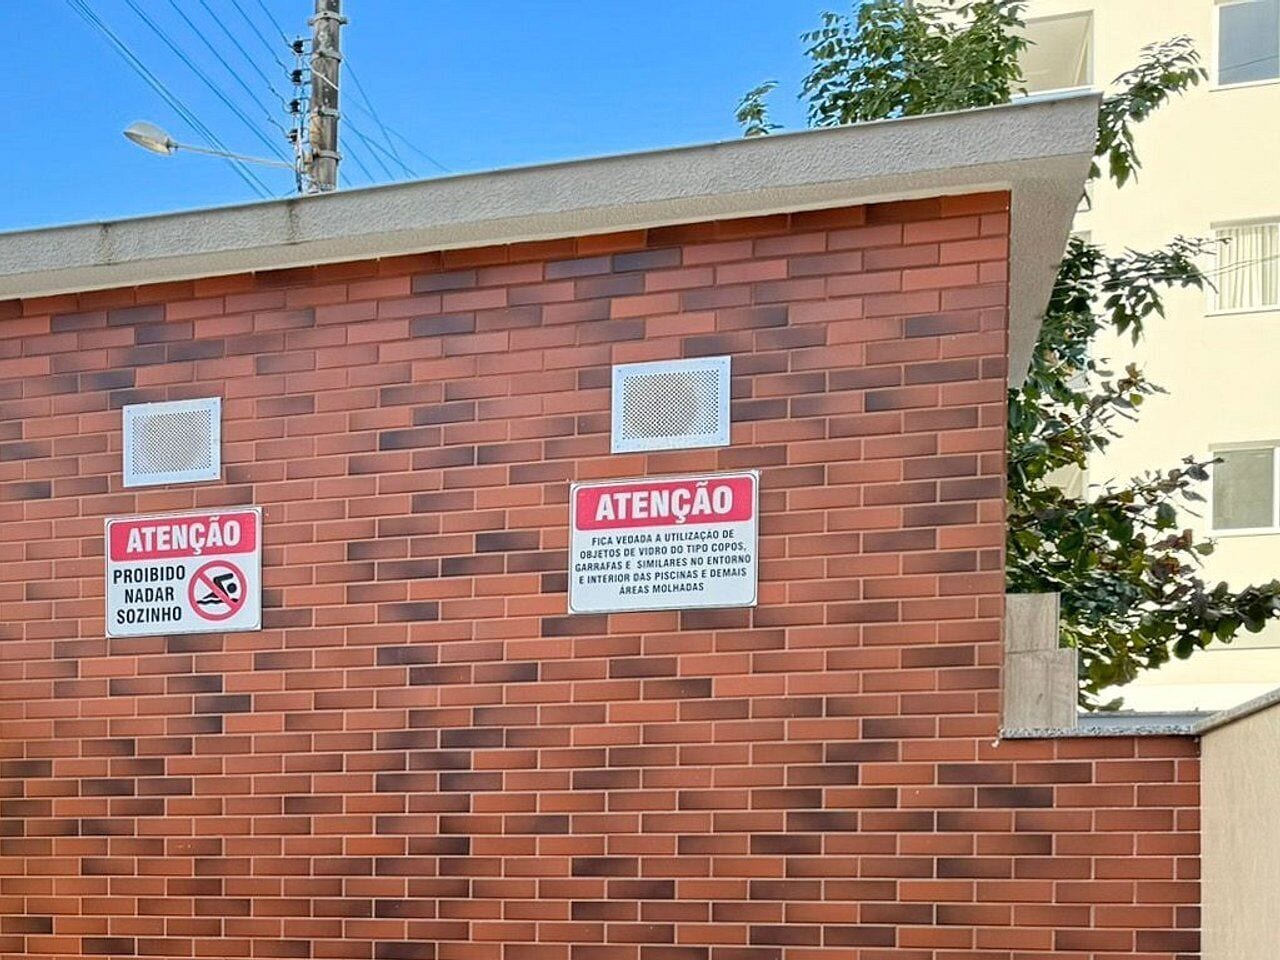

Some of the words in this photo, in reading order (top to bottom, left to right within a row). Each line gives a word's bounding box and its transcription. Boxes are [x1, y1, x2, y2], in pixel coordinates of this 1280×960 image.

[594, 482, 733, 524] ATENÇÃO
[126, 517, 241, 555] ATENÇÃO
[592, 536, 613, 546] FICA
[616, 534, 652, 545] VEDADA
[655, 534, 661, 543] A
[723, 529, 734, 538] DE
[580, 549, 620, 559] OBJETOS
[624, 548, 635, 557] DE
[639, 546, 668, 556] VIDRO
[671, 545, 683, 554] DO
[687, 544, 708, 553] TIPO
[575, 561, 622, 572] GARRAFAS
[626, 560, 631, 569] E
[637, 557, 688, 569] SIMILARES
[691, 557, 703, 566] NO
[707, 554, 751, 565] ENTORNO
[113, 565, 185, 584] PROIBIDO
[579, 576, 584, 584] E
[588, 573, 630, 584] INTERIOR
[633, 572, 651, 582] DAS
[655, 569, 698, 580] PISCINAS
[702, 569, 707, 578] E
[710, 568, 747, 578] DEMAIS
[125, 587, 174, 604] NADAR
[653, 582, 704, 593] MOLHADAS
[117, 606, 182, 624] SOZINHO
